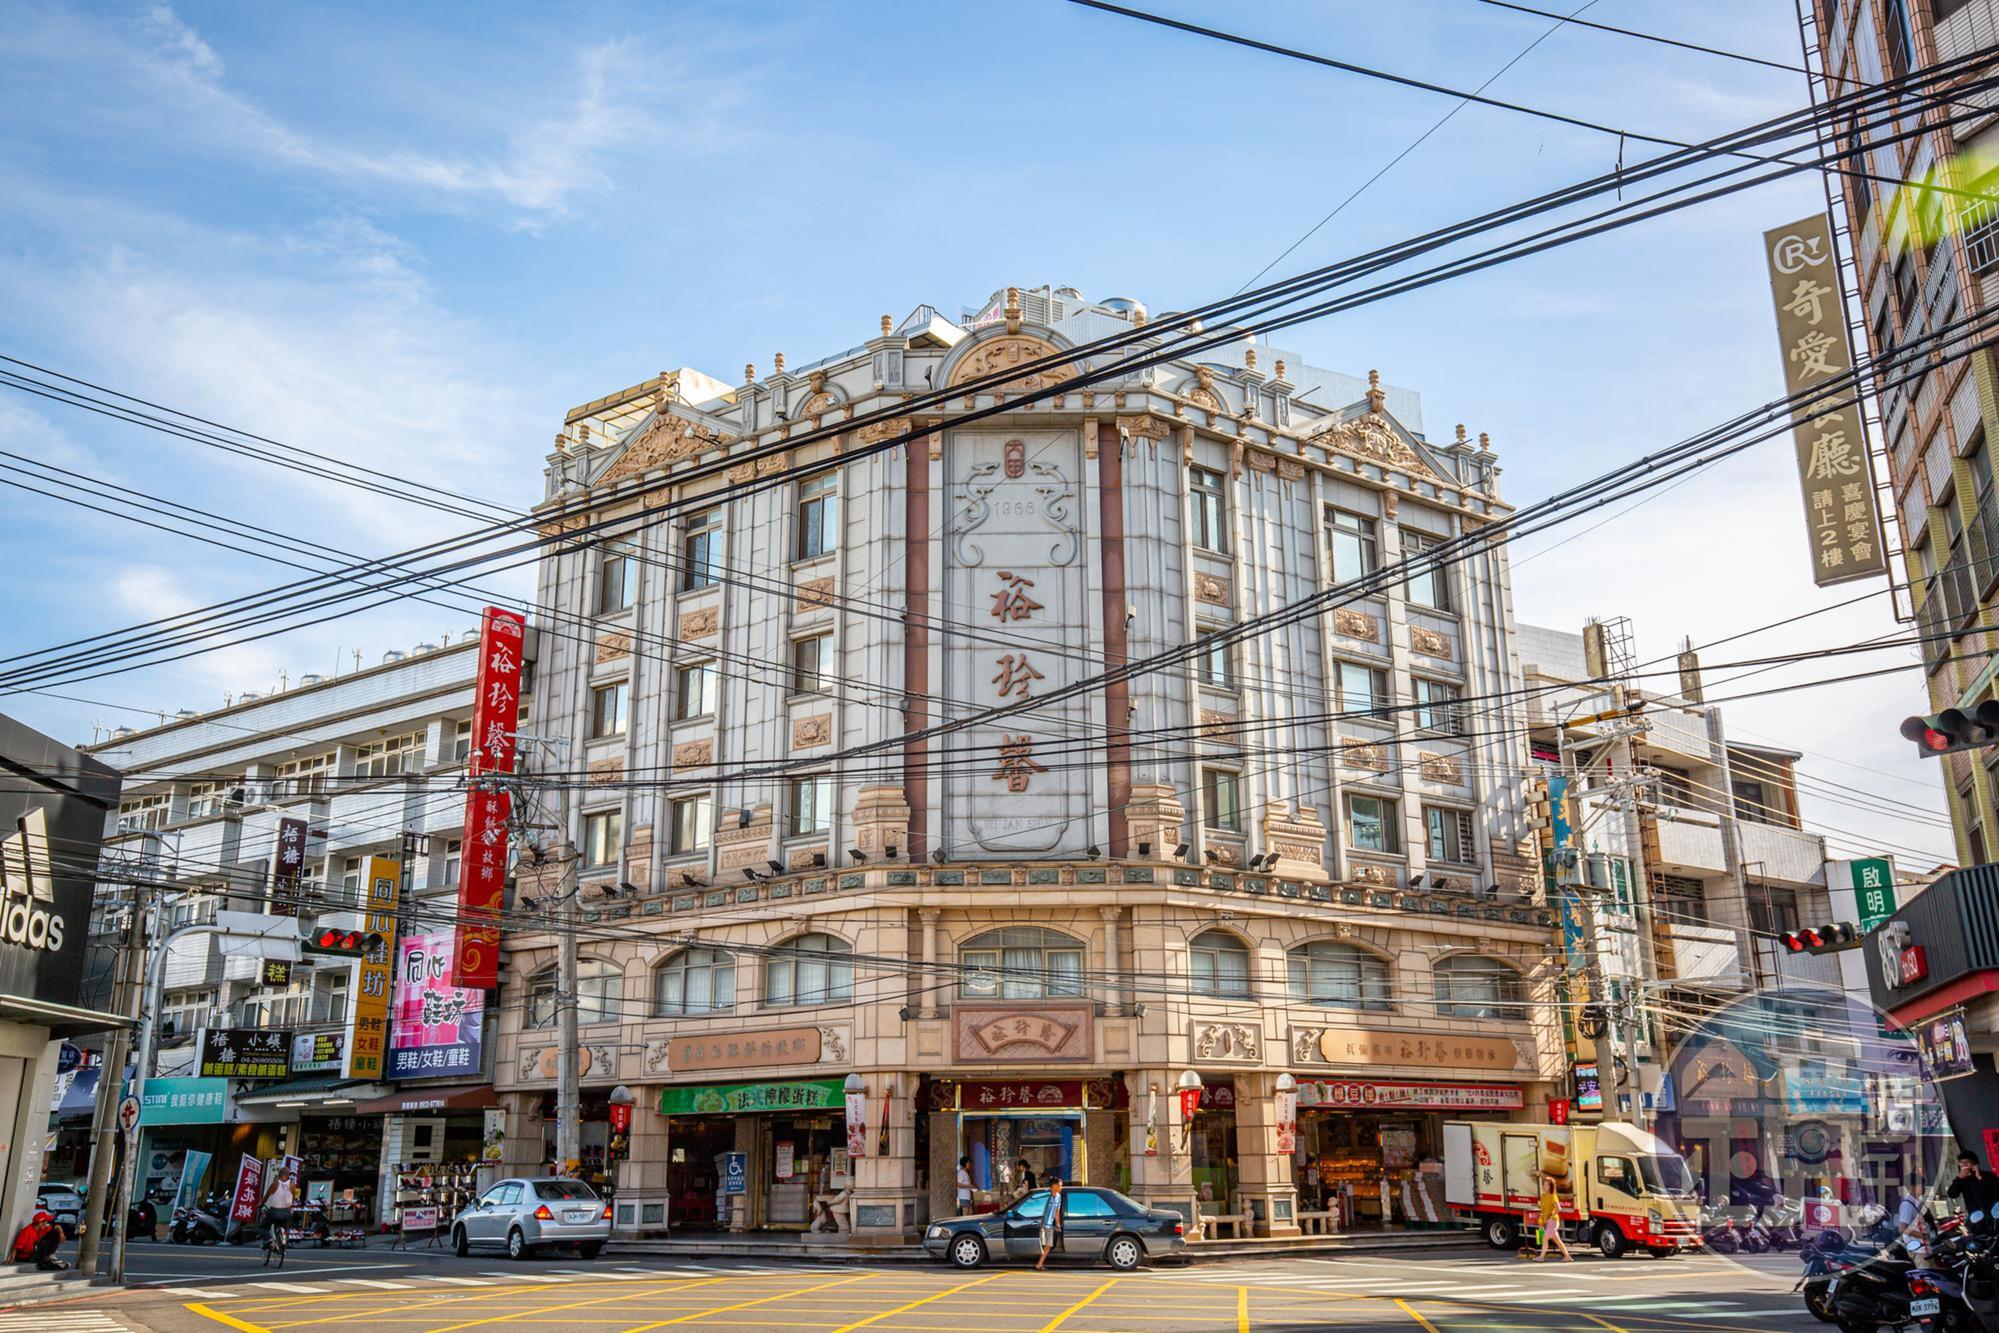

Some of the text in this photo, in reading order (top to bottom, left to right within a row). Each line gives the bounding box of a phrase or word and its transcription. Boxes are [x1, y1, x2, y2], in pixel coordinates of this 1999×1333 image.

[1812, 488, 1844, 568] 請上2樓
[1841, 482, 1873, 563] 喜慶宴會
[484, 640, 516, 757] 裕珍馨
[990, 571, 1049, 793] 裕珍馨
[0, 887, 65, 951] idas
[356, 1036, 379, 1050] 女鞋
[358, 1017, 382, 1032] 男鞋
[396, 1047, 470, 1070] 男鞋/女鞋/童鞋
[980, 1086, 1034, 1105] 裕珍馨
